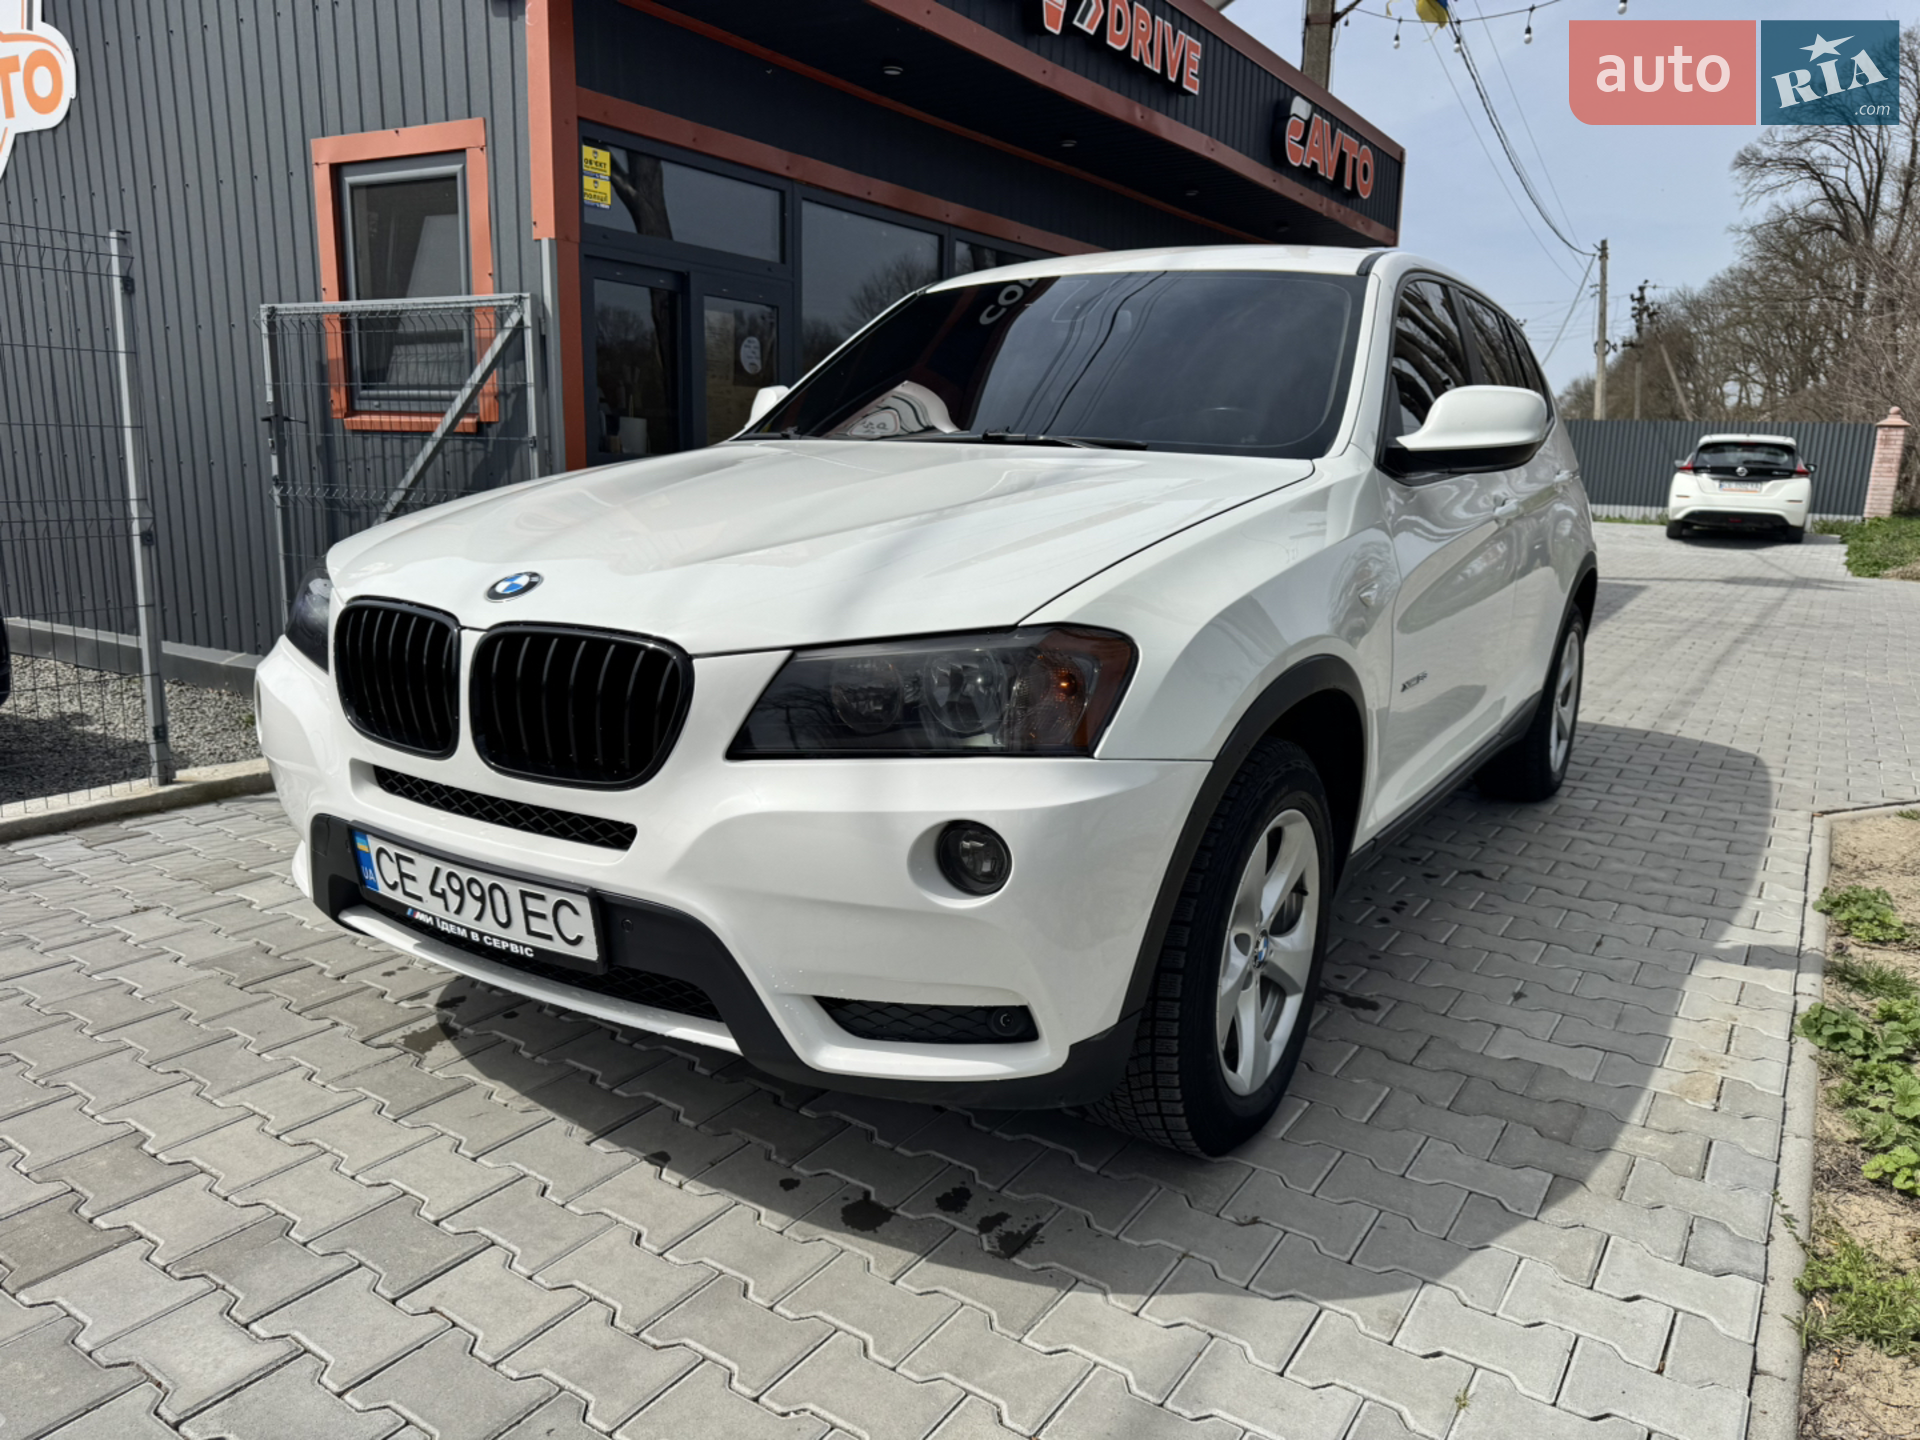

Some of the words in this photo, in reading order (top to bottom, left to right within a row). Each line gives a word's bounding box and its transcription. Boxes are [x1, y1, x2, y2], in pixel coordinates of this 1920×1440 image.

[1106, 0, 1202, 95] DRIVE
[376, 846, 424, 903] CE
[428, 866, 513, 929] 4990
[519, 888, 585, 947] EC
[470, 931, 480, 943] В
[482, 935, 535, 958] СЕРВІС
